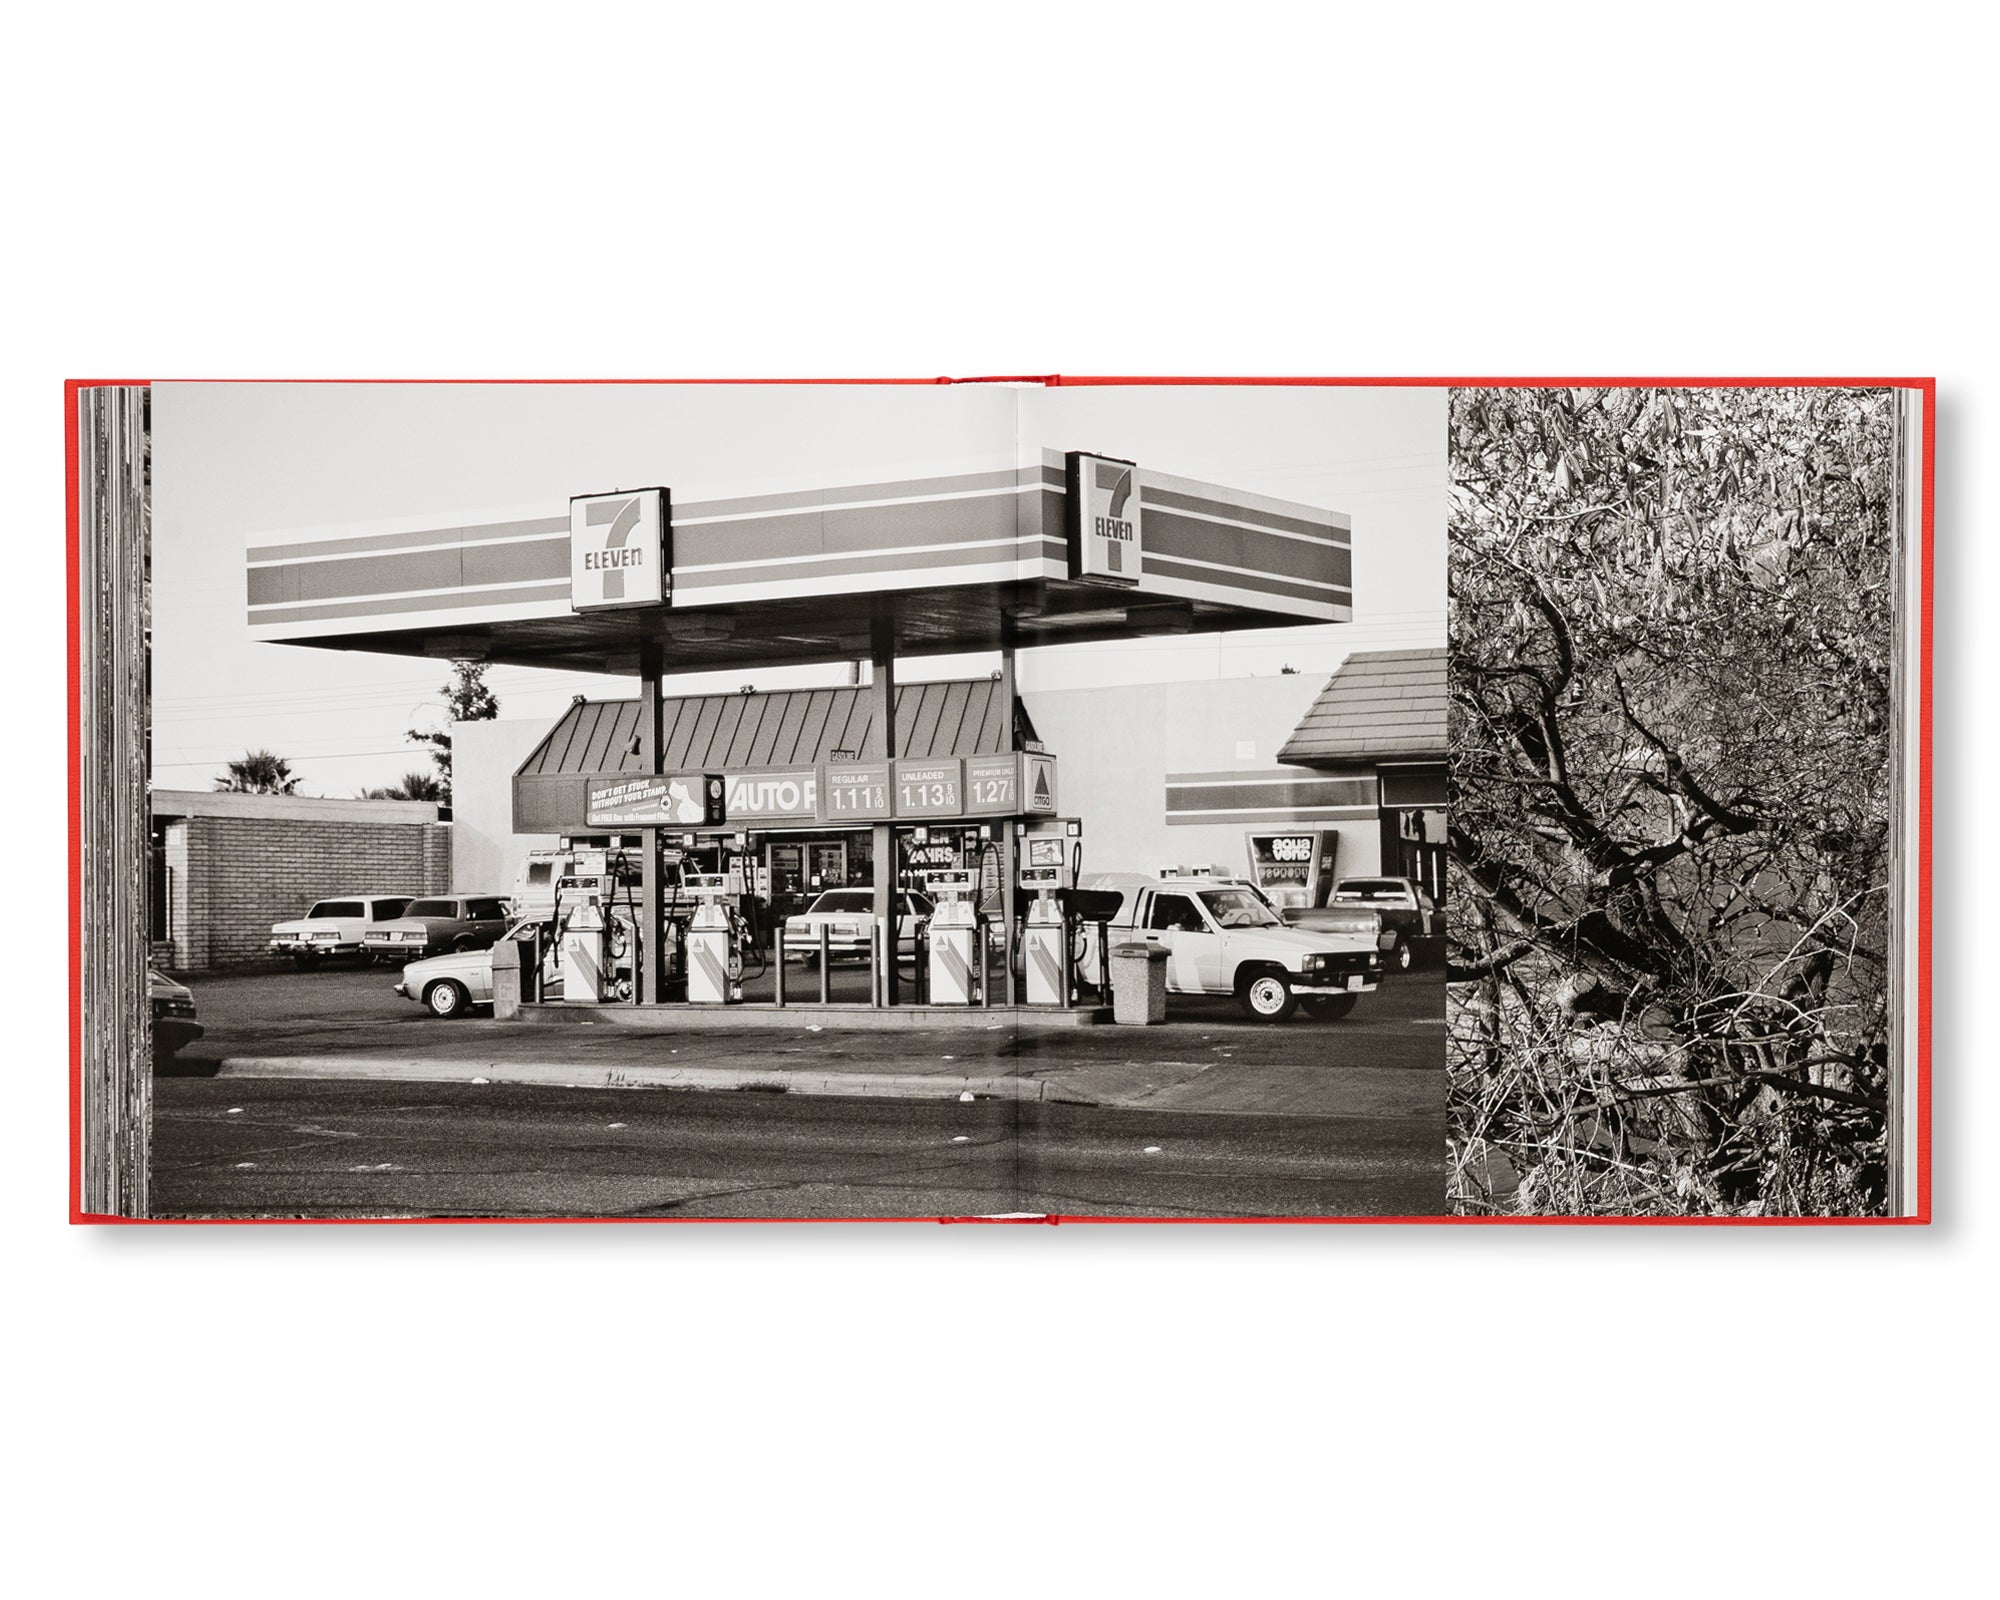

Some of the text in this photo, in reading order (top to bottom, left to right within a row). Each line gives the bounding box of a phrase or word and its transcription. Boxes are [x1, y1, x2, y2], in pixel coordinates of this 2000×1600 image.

[1095, 463, 1131, 572] 7
[586, 497, 640, 600] 7
[832, 775, 868, 784] REGULAR
[901, 771, 944, 781] UNLEADED
[972, 768, 1001, 777] PREMIUM
[591, 780, 649, 801] DON'T GET STUCK
[591, 796, 624, 811] WITHOUT
[624, 790, 642, 803] YOUR
[728, 781, 800, 811] AUTO
[832, 788, 872, 810] 1.11
[902, 784, 944, 807] 1.13
[973, 780, 1009, 803] 1.27
[1034, 795, 1050, 806] CITGO
